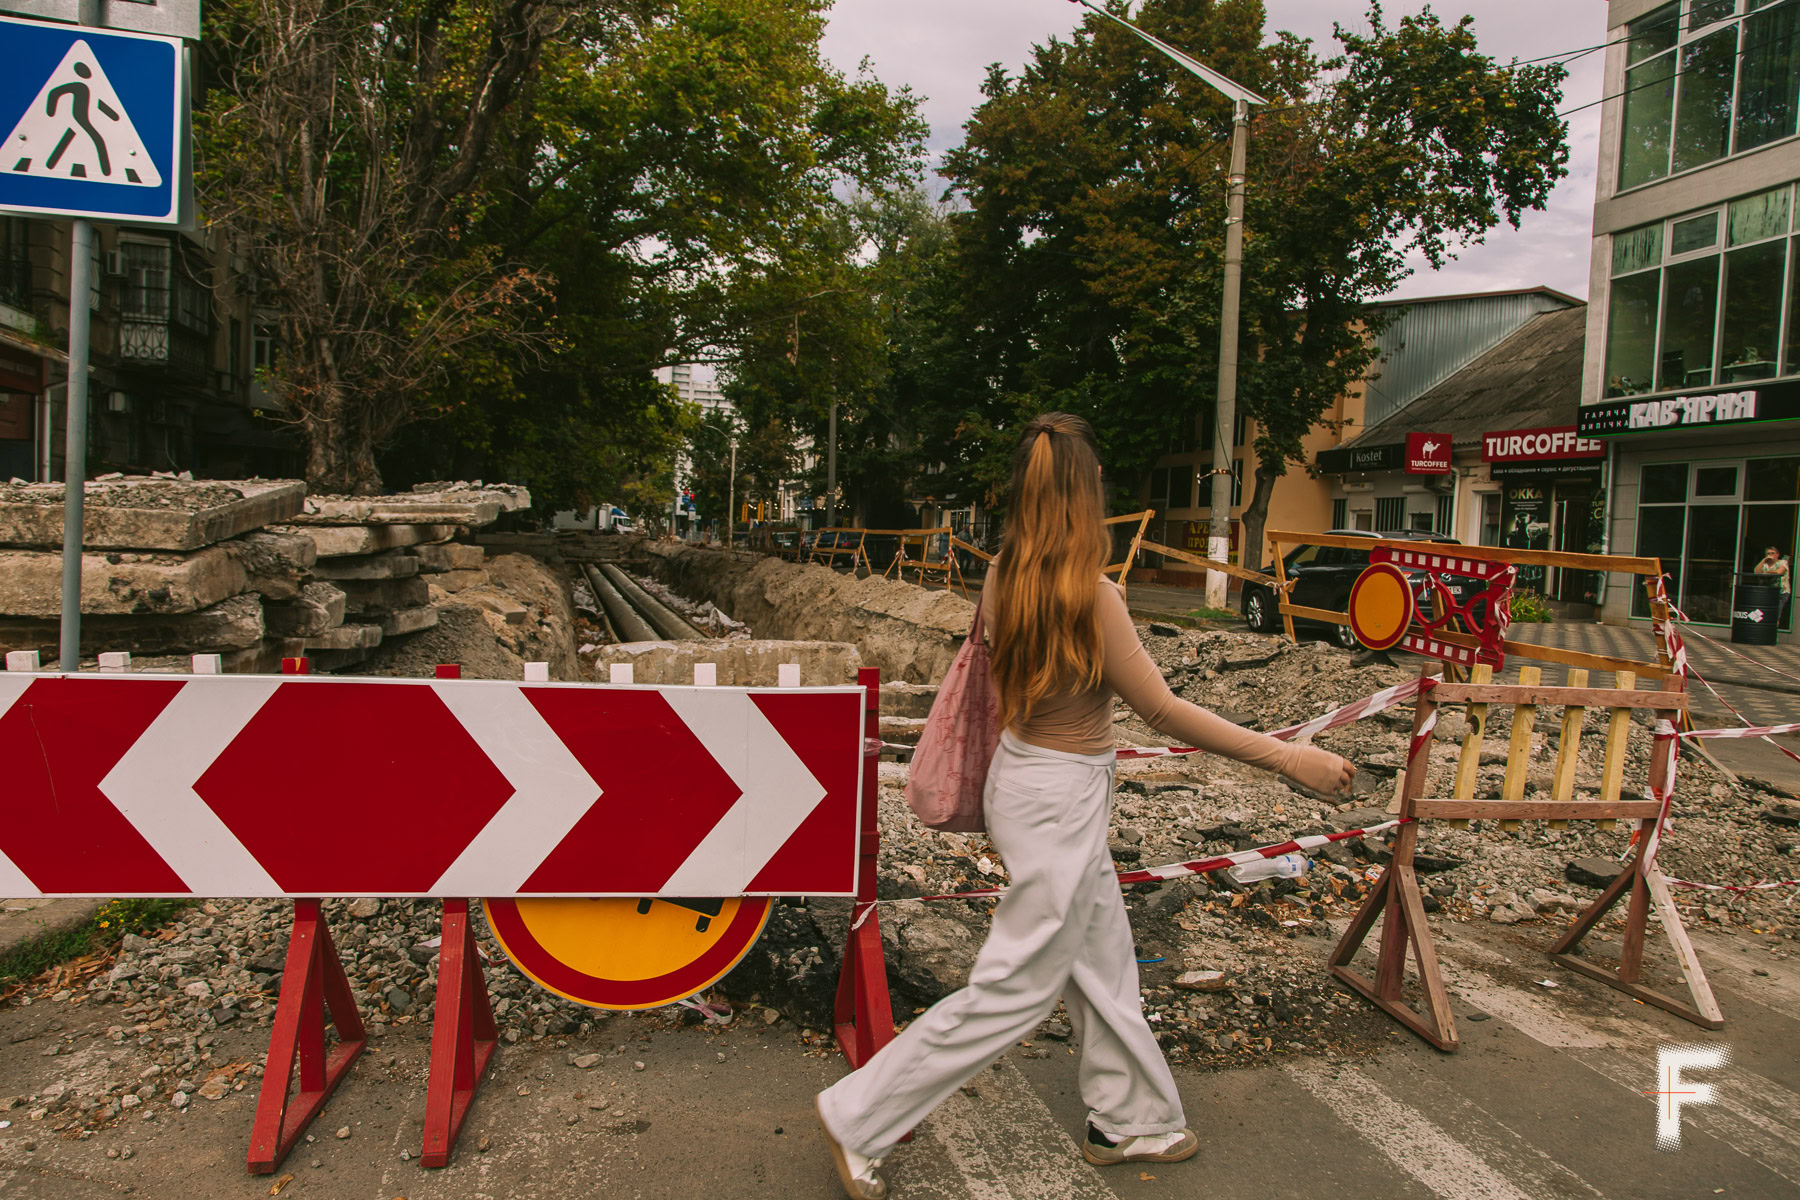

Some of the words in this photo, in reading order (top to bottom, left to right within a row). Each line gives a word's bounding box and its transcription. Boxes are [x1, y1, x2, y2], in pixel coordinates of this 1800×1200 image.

[1584, 408, 1627, 420] ГАРЯЧА
[1628, 390, 1757, 429] КАВ'ЯРНЯ
[1580, 419, 1629, 431] ВИПІЧКА
[1485, 431, 1602, 457] TURCOFFEE
[1355, 450, 1382, 463] Kostet
[1411, 460, 1448, 468] TURCOFFEE
